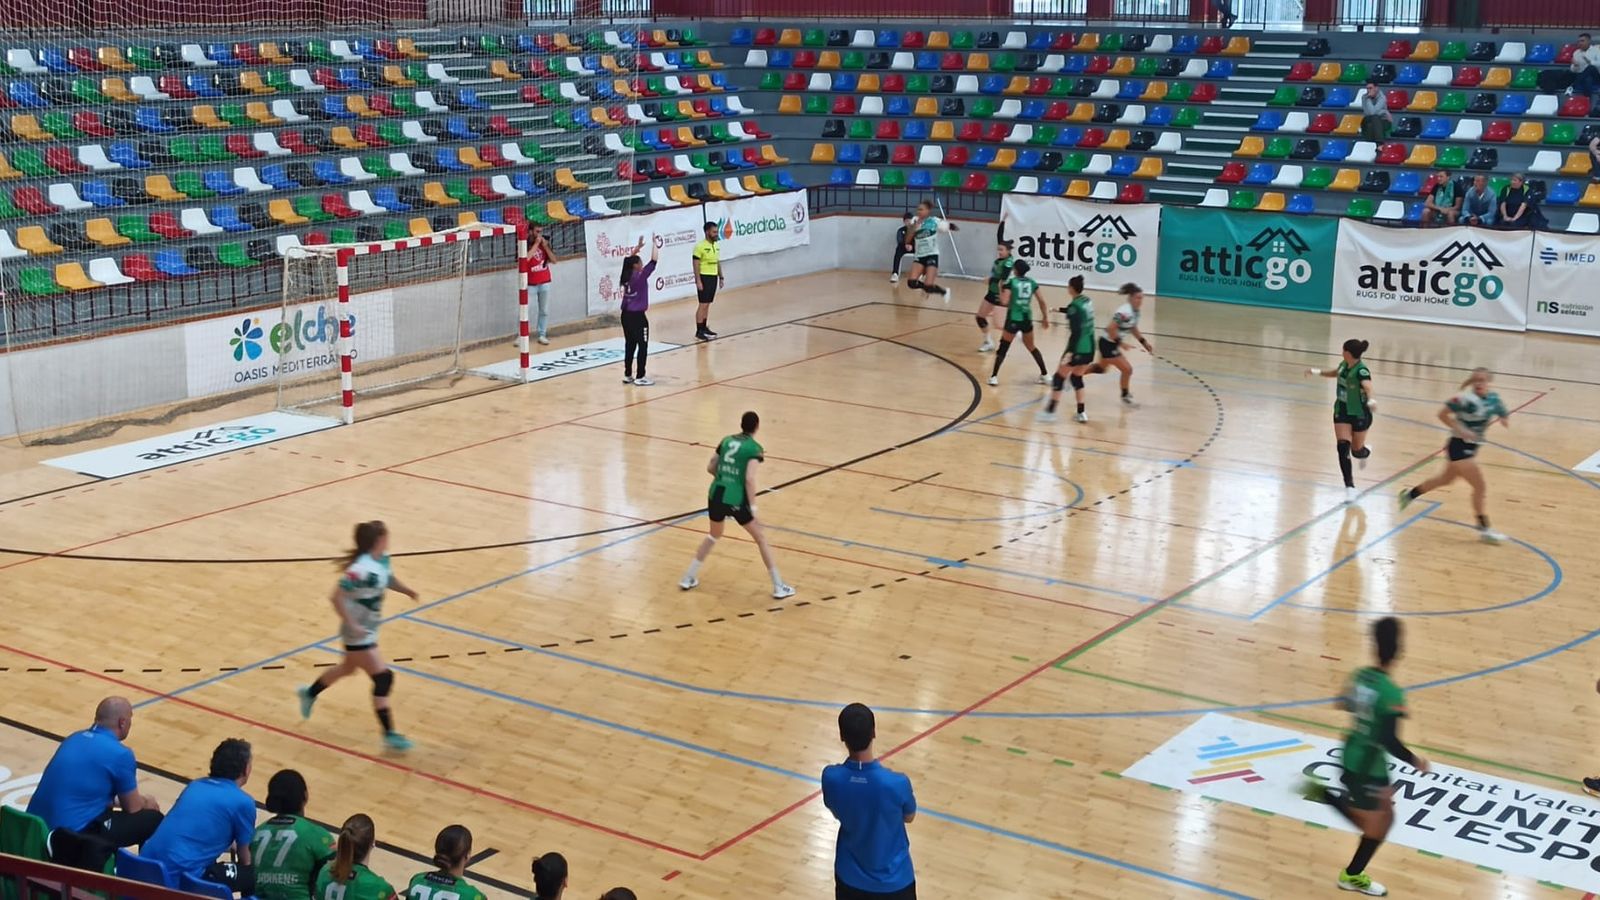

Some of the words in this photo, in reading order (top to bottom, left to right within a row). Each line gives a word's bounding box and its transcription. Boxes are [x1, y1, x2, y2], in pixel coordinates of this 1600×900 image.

[734, 213, 787, 236] Iberdrola
[1017, 229, 1137, 274] atticgo
[1564, 252, 1596, 263] IMED
[1036, 260, 1051, 269] FOR
[1052, 261, 1071, 270] YOUR
[1073, 264, 1093, 273] HOME
[1179, 244, 1312, 291] atticgo
[1179, 273, 1198, 282] RUGS
[1200, 275, 1214, 284] FOR
[1217, 277, 1238, 286] YOUR
[1240, 280, 1262, 289] HOME
[1357, 260, 1504, 308] atticgo
[1356, 289, 1378, 300] RUGS
[1379, 292, 1397, 301] FOR
[1399, 294, 1422, 304] YOUR
[1424, 296, 1450, 306] HOME
[1536, 300, 1560, 314] ns
[1560, 309, 1587, 317] selecta
[234, 366, 269, 383] OASIS
[272, 349, 359, 376] MEDITERRÁO
[136, 427, 277, 461] atticgo
[723, 440, 742, 464] 2
[1302, 761, 1600, 844] CMUNIT
[254, 829, 298, 868] 77
